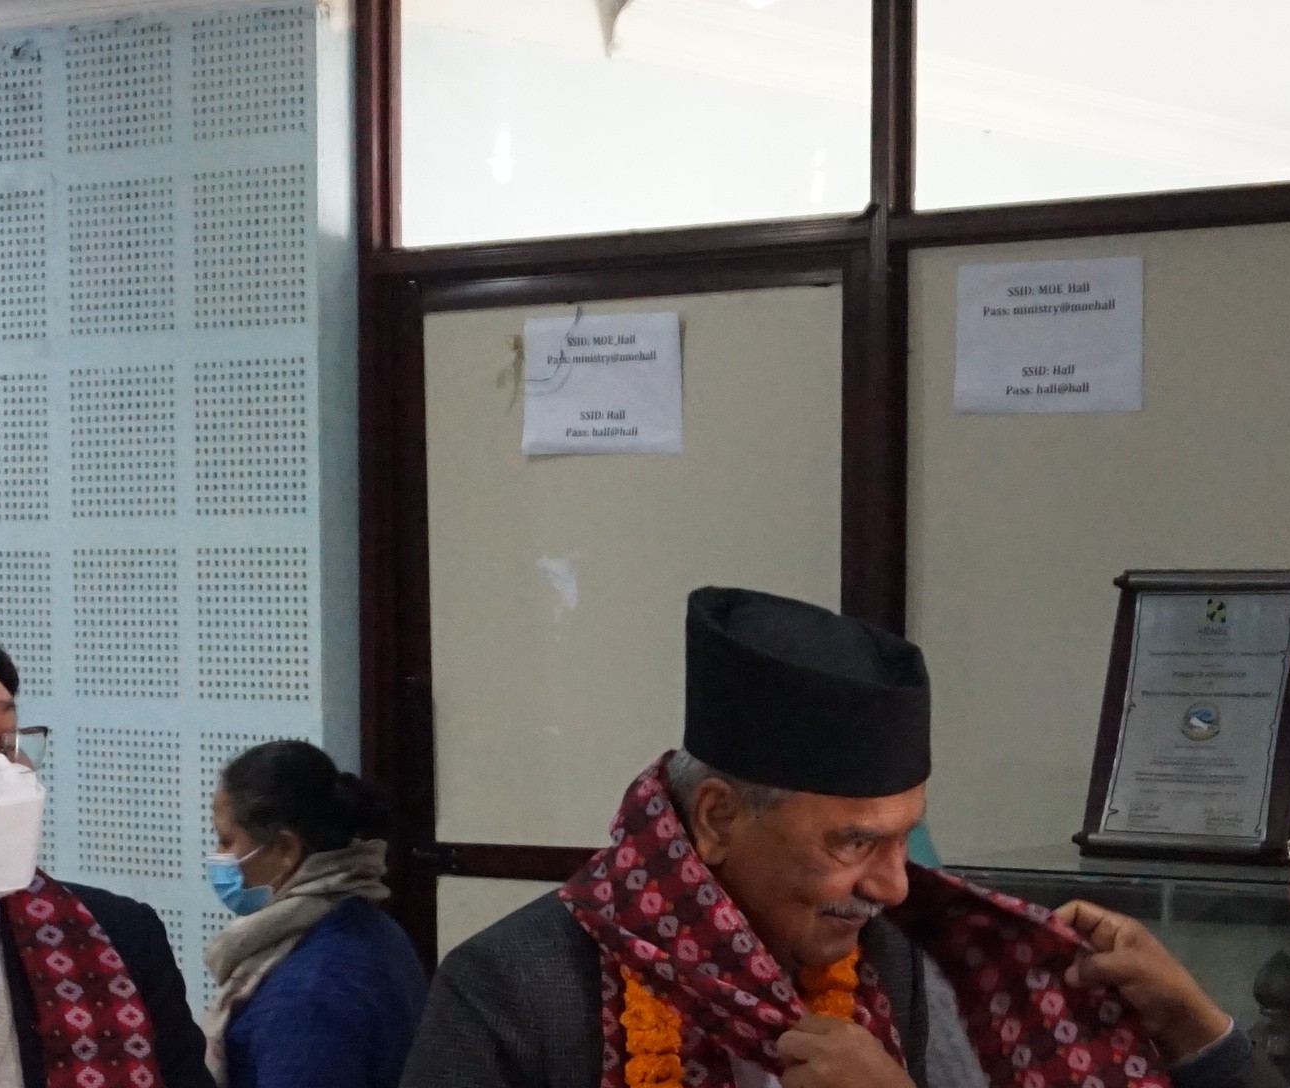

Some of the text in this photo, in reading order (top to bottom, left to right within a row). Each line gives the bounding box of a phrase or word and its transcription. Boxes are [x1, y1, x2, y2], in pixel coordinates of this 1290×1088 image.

[1007, 282, 1090, 297] SSID: MOE_Hall
[983, 306, 1010, 317] Pass:
[1022, 365, 1075, 377] SSID: Hall
[1006, 385, 1034, 396] Pass:
